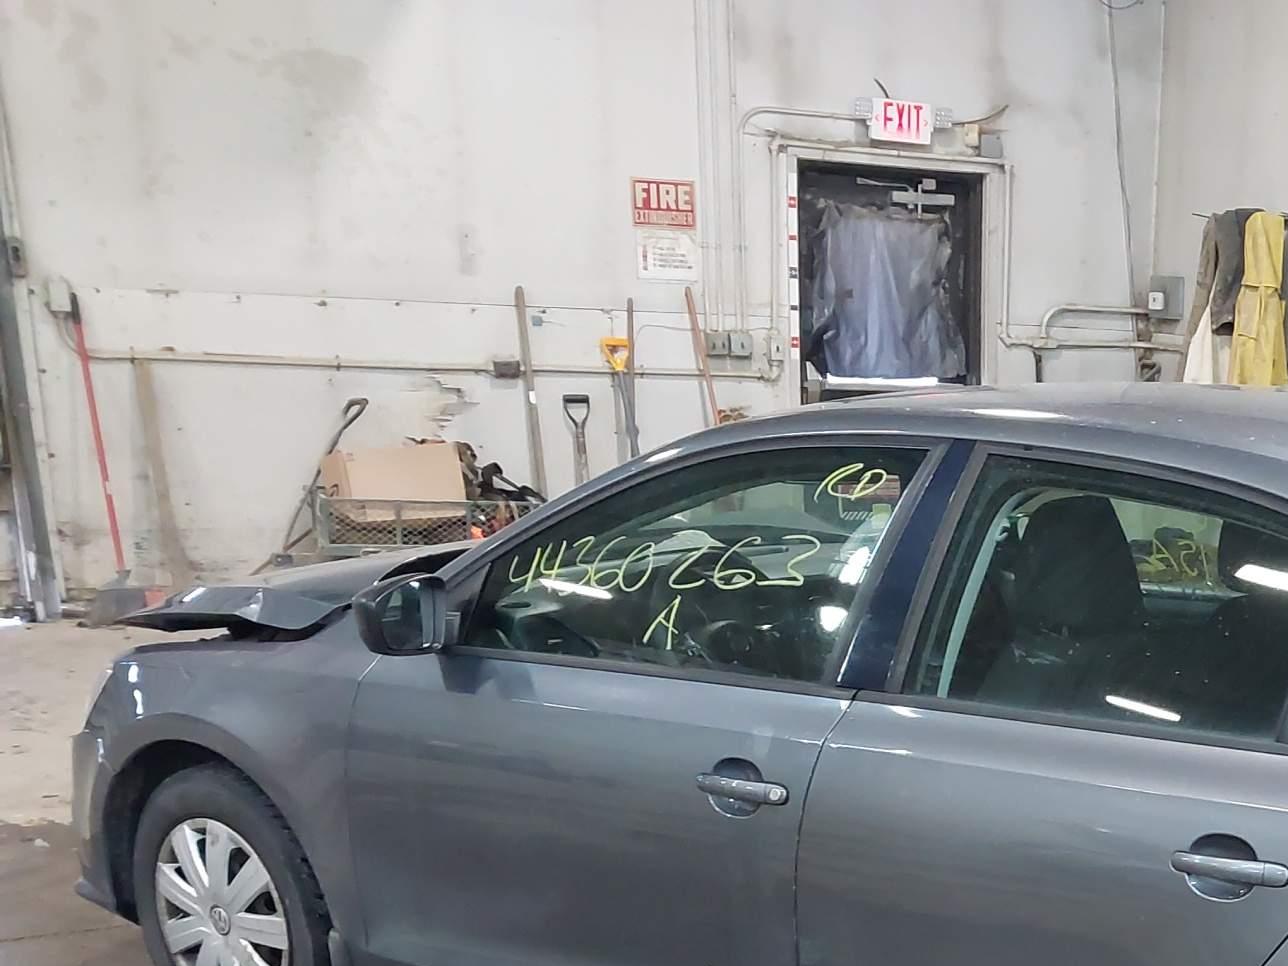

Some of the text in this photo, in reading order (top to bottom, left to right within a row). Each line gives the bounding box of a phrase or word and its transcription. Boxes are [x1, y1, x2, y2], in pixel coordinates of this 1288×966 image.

[883, 101, 923, 137] EXIT
[634, 182, 692, 210] FIRE
[509, 535, 821, 594] 44360263
[642, 594, 682, 650] A
